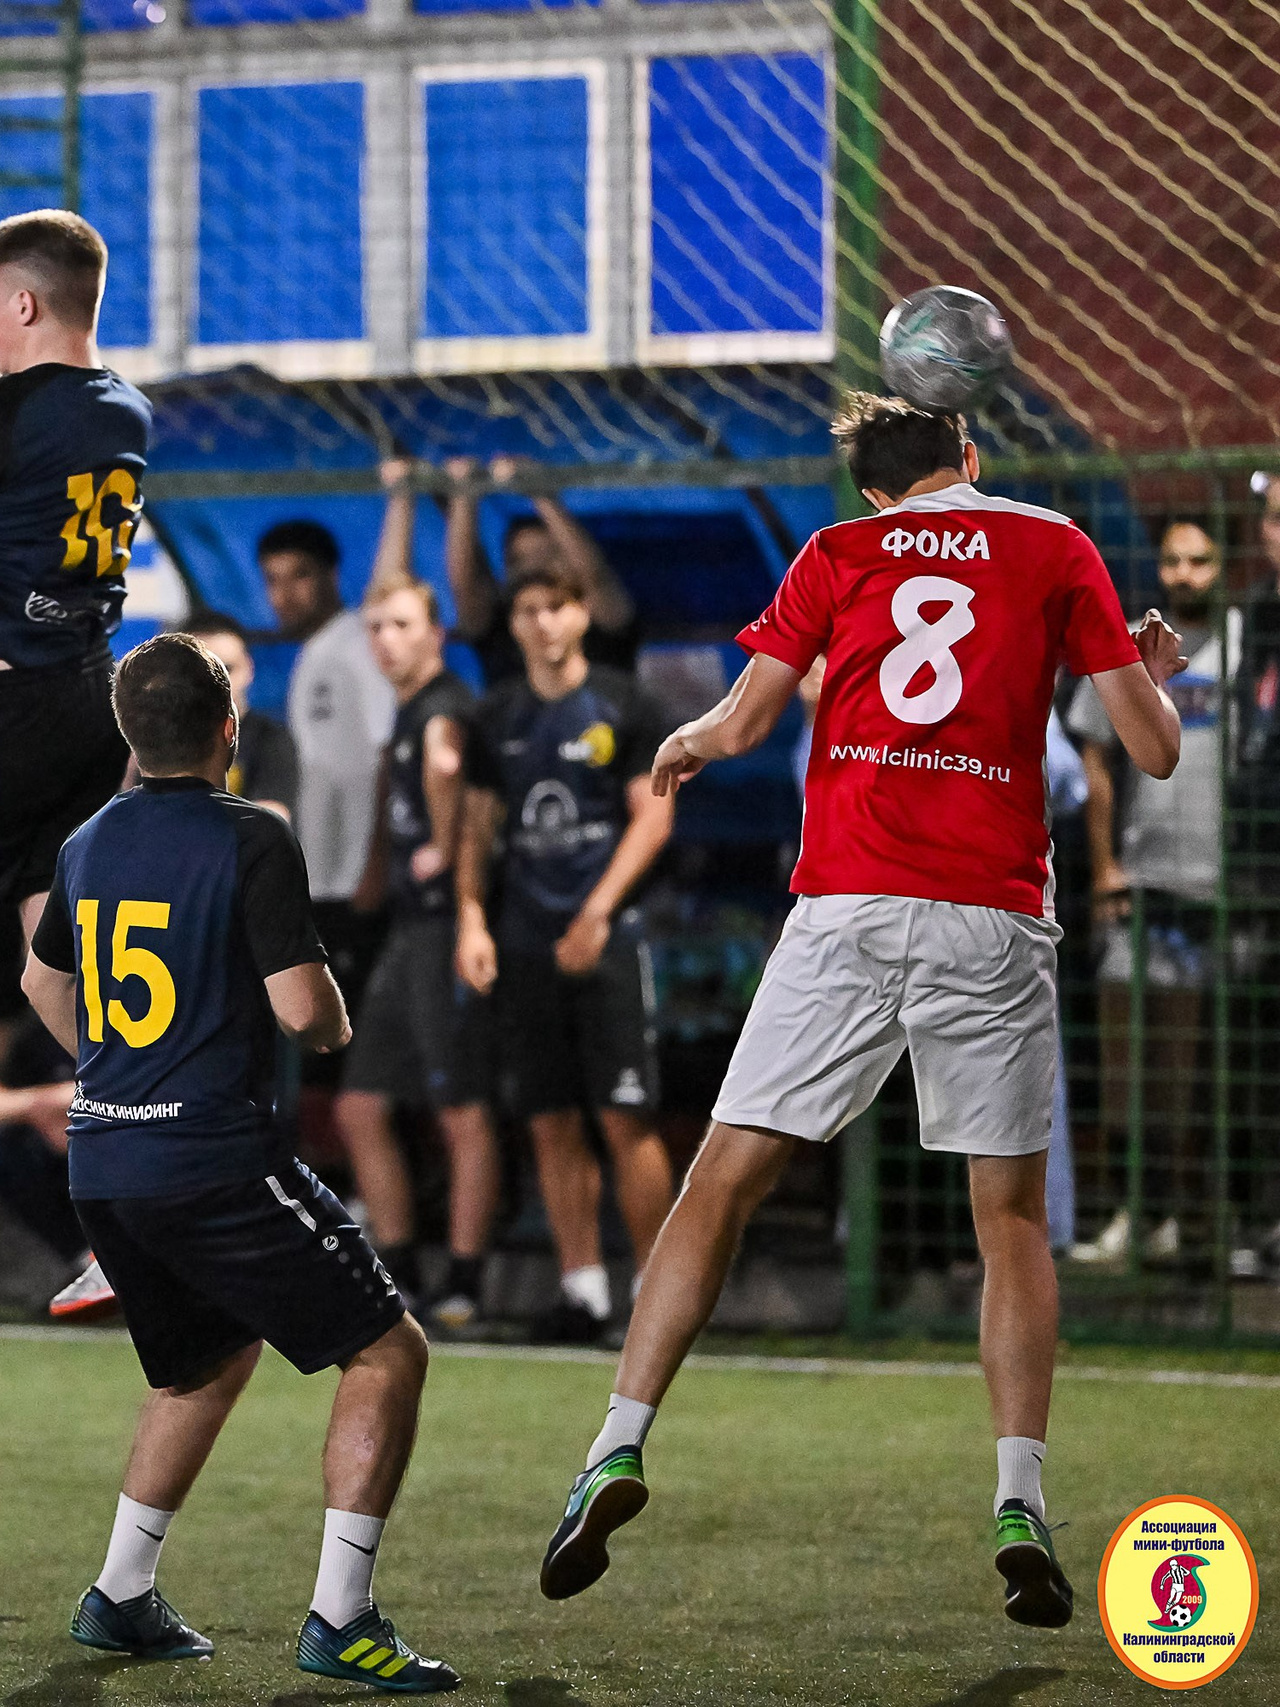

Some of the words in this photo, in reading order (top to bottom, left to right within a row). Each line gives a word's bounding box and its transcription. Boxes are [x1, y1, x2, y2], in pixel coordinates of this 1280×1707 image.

[881, 528, 990, 561] ФОКА
[879, 575, 976, 725] 8
[830, 744, 1011, 783] www.lclinic39.ru
[76, 899, 177, 1049] 15
